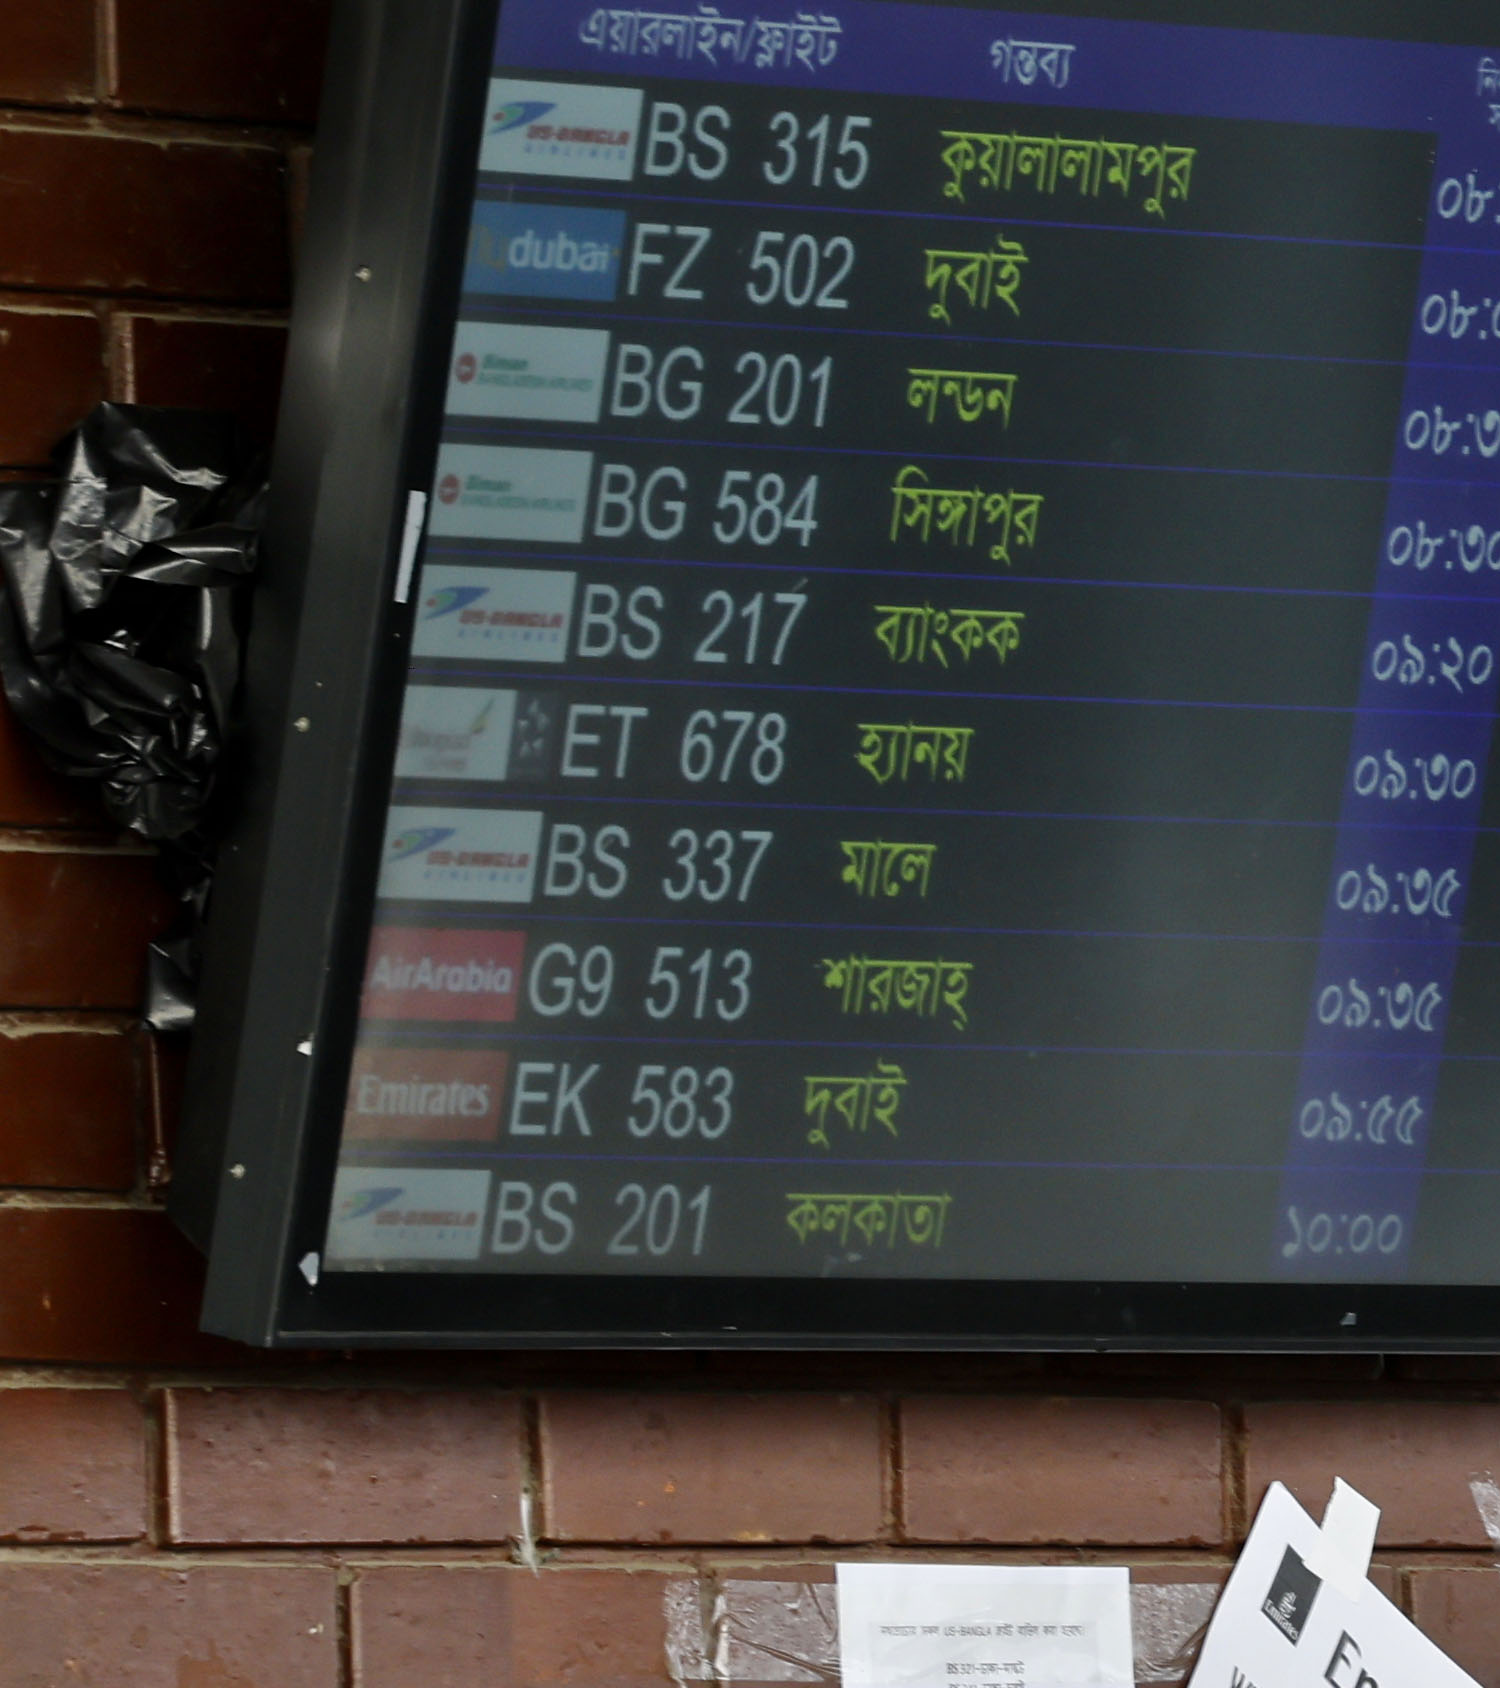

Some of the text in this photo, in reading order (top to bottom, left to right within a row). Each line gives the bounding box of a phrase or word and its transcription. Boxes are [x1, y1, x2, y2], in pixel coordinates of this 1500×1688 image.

[990, 39, 1075, 88] গন্তব্য
[644, 102, 872, 189] BS 315
[941, 131, 1196, 216] কুয়ালালামপুর
[628, 223, 854, 308] FZ 502
[925, 238, 1028, 322] দুবাই
[611, 344, 832, 427] BG 201
[908, 369, 1017, 422] লন্ডন
[594, 464, 818, 546] BG 584
[891, 465, 1044, 564] সিঙ্গাপুর
[578, 584, 807, 665] BS 217
[875, 606, 1025, 667] ব্যাংকক
[1372, 634, 1492, 692] ০৯:২০
[561, 704, 786, 784] ET 678
[855, 723, 974, 783] হ্যানয়
[1354, 749, 1475, 801] ০৯:৩০
[544, 824, 773, 902] BS 337
[841, 841, 936, 896] মালে
[1336, 864, 1460, 917] ০৯:৩৫
[369, 956, 513, 994] AirArabia
[528, 943, 751, 1021] G9 513
[822, 956, 973, 1030] শারজাহ্
[1317, 978, 1442, 1031] ০৯:৩৫
[356, 1074, 491, 1117] Emirates
[509, 1062, 733, 1139] EK 583
[805, 1061, 907, 1146] দুবাই
[1299, 1092, 1423, 1144] ০৯:৫৫
[491, 1182, 711, 1255] BS 201
[786, 1193, 952, 1246] কলকাতা
[1282, 1205, 1402, 1259] ১০:০০
